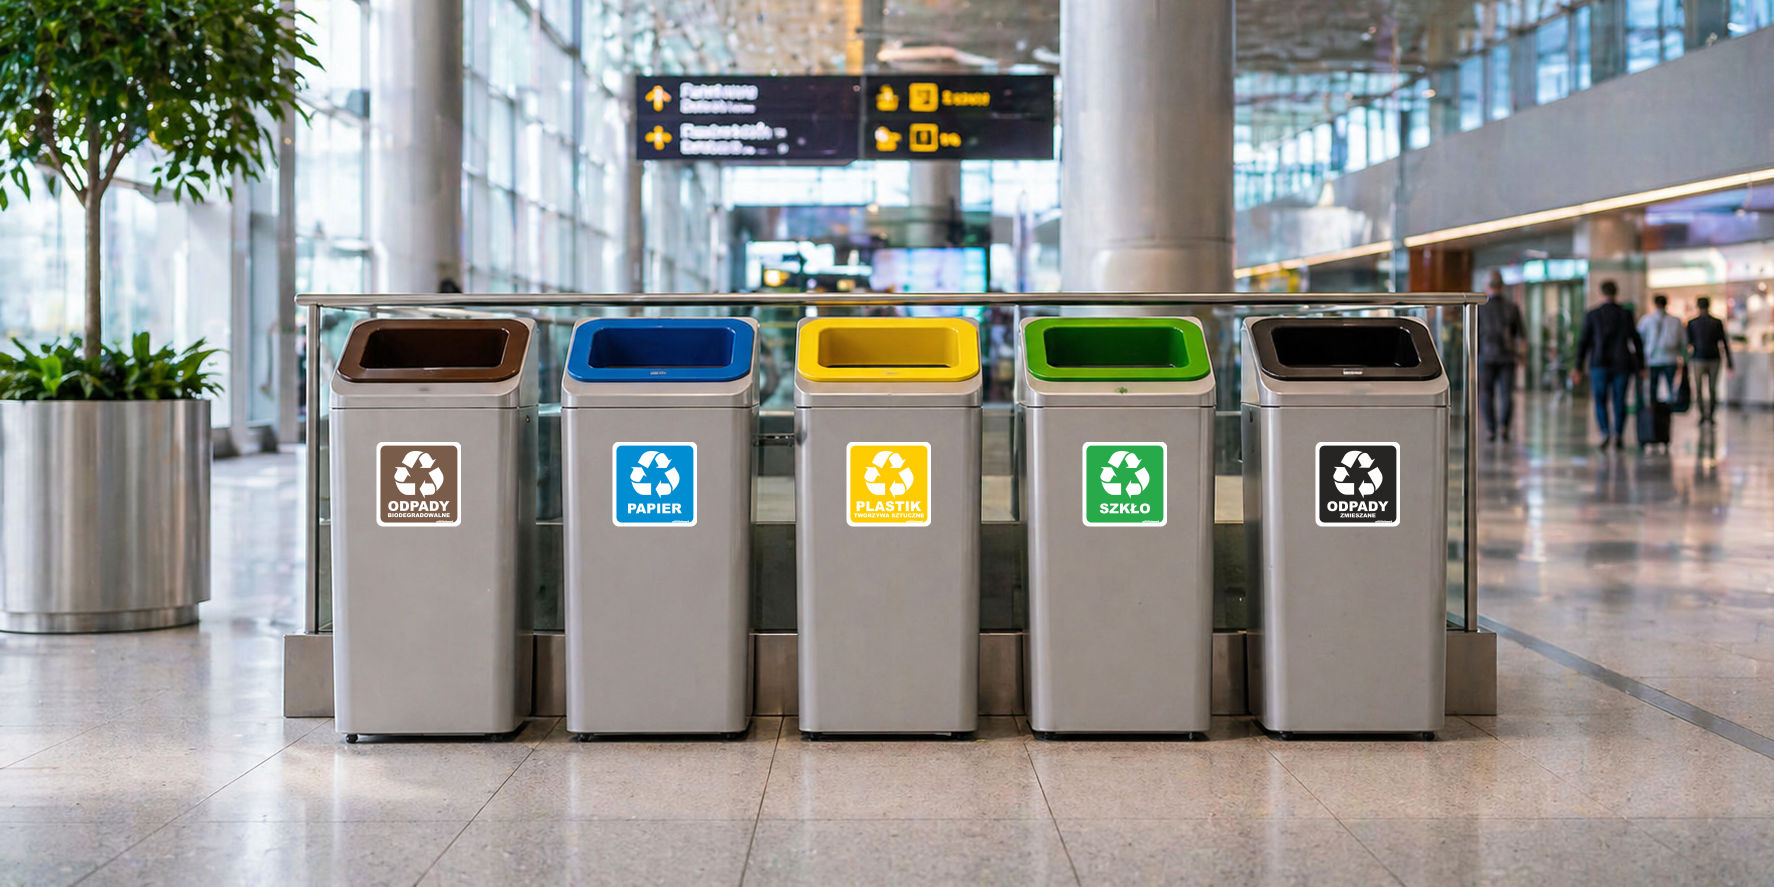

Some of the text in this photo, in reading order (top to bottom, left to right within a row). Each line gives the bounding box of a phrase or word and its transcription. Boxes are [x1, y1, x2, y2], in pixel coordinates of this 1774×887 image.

[388, 500, 450, 512] ODPADY
[627, 503, 682, 514] PAPIER
[856, 500, 921, 512] PLASTIK
[1099, 503, 1151, 514] SZKŁO
[1327, 500, 1389, 512] ODPADY
